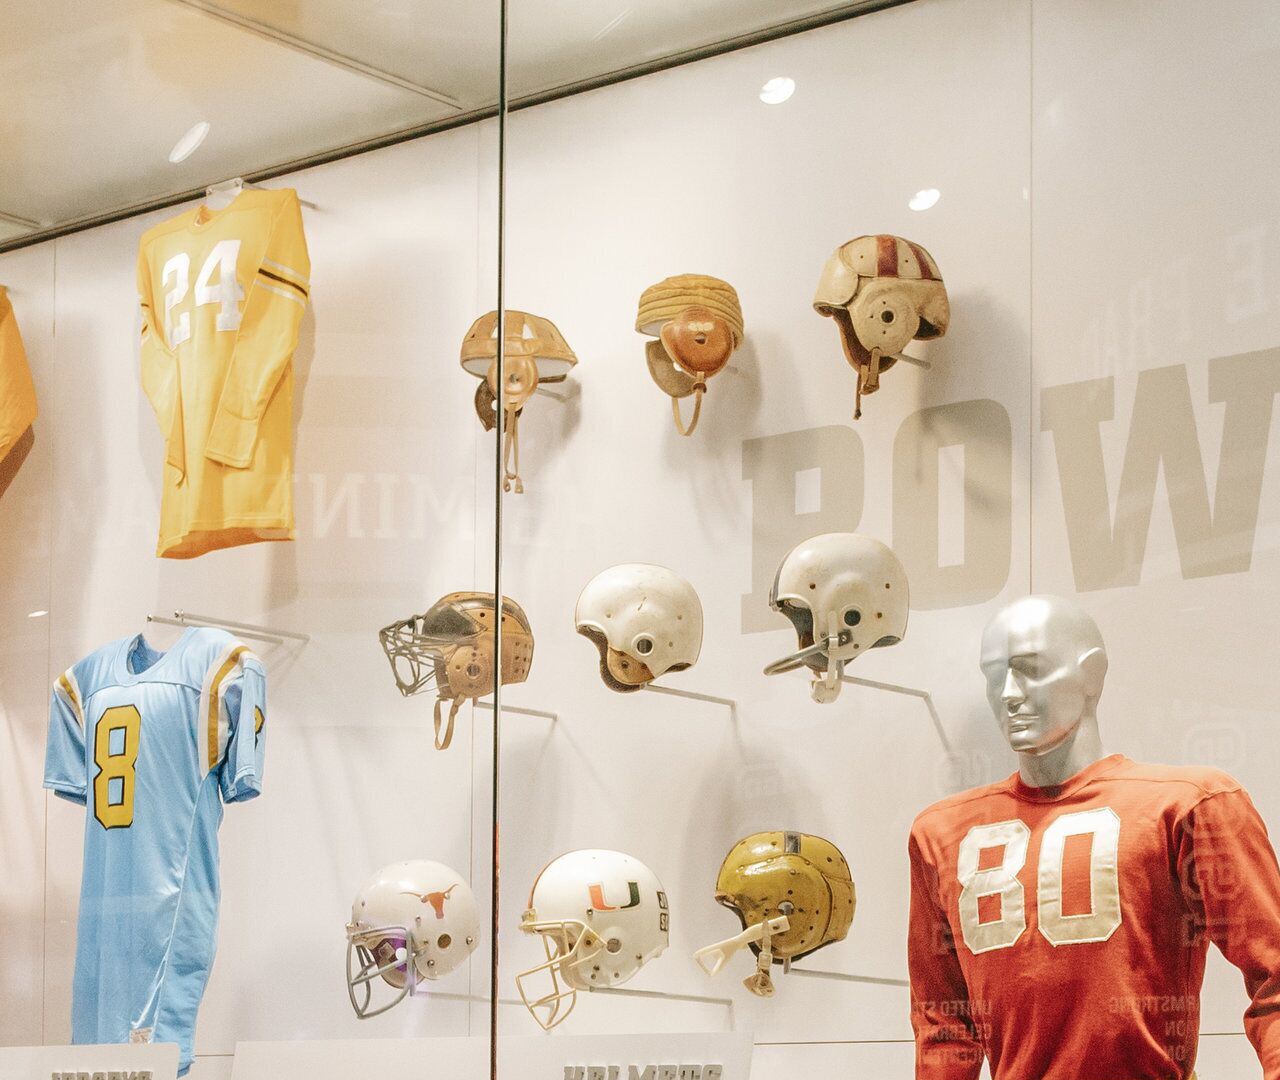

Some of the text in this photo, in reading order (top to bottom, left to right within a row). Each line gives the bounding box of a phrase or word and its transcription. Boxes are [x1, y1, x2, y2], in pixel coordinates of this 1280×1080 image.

[161, 238, 244, 350] 24
[94, 703, 141, 831] 8
[588, 882, 640, 912] U
[957, 806, 1122, 955] 80
